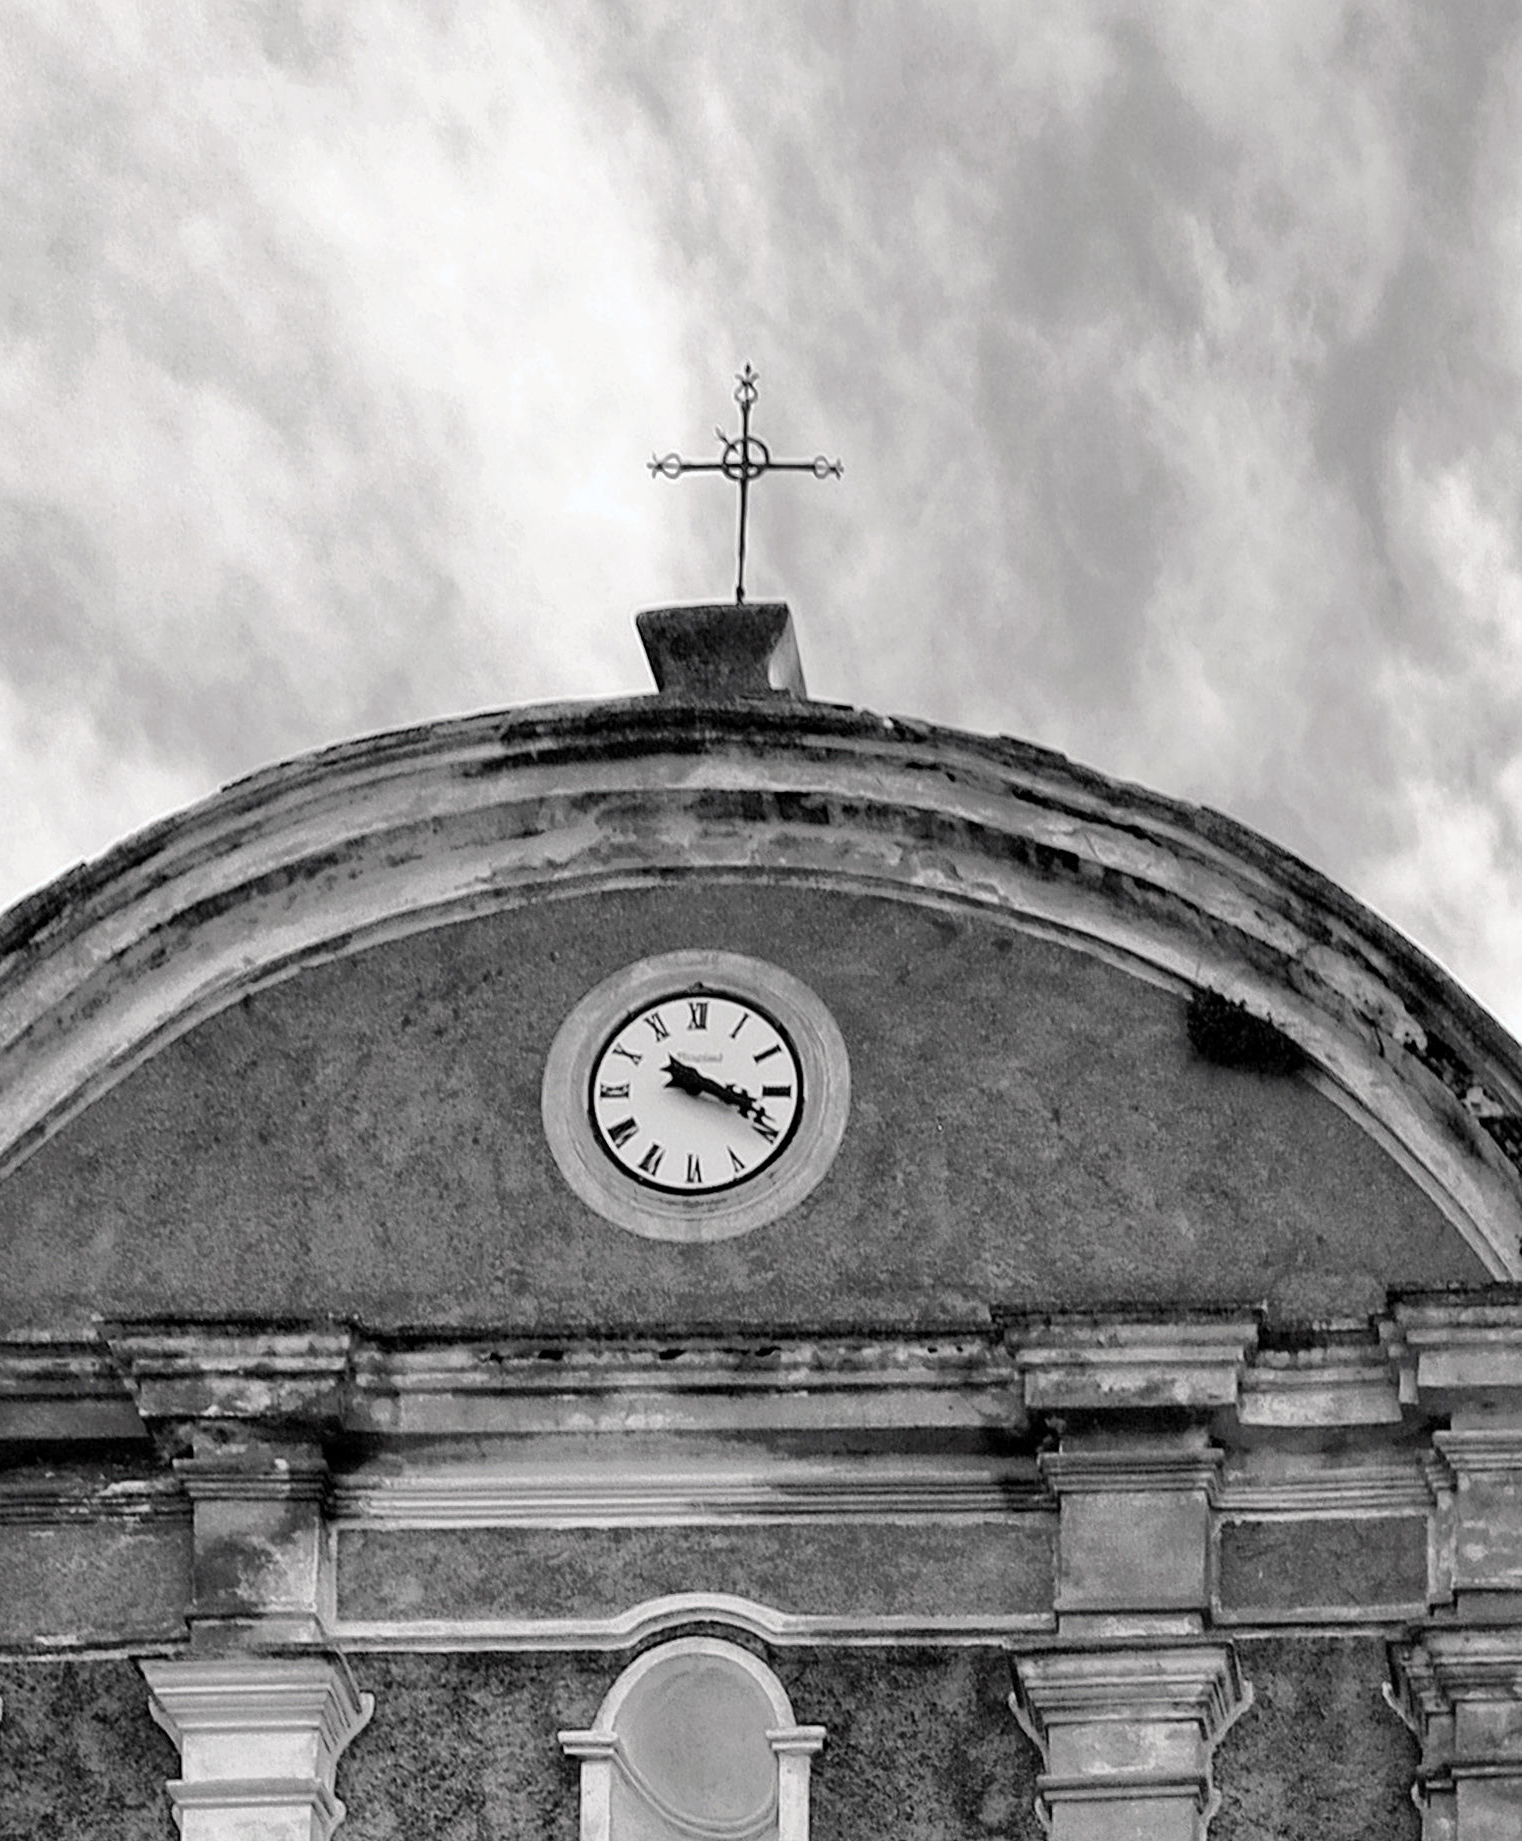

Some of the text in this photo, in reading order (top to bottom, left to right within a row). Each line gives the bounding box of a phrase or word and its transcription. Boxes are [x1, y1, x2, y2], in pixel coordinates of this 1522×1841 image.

[644, 1012, 670, 1042] XI
[688, 1002, 708, 1030] XII
[730, 1013, 749, 1039] I
[612, 1042, 642, 1065] X
[762, 1085, 791, 1098] III
[687, 1154, 702, 1183] VI
[727, 1145, 745, 1173] V
